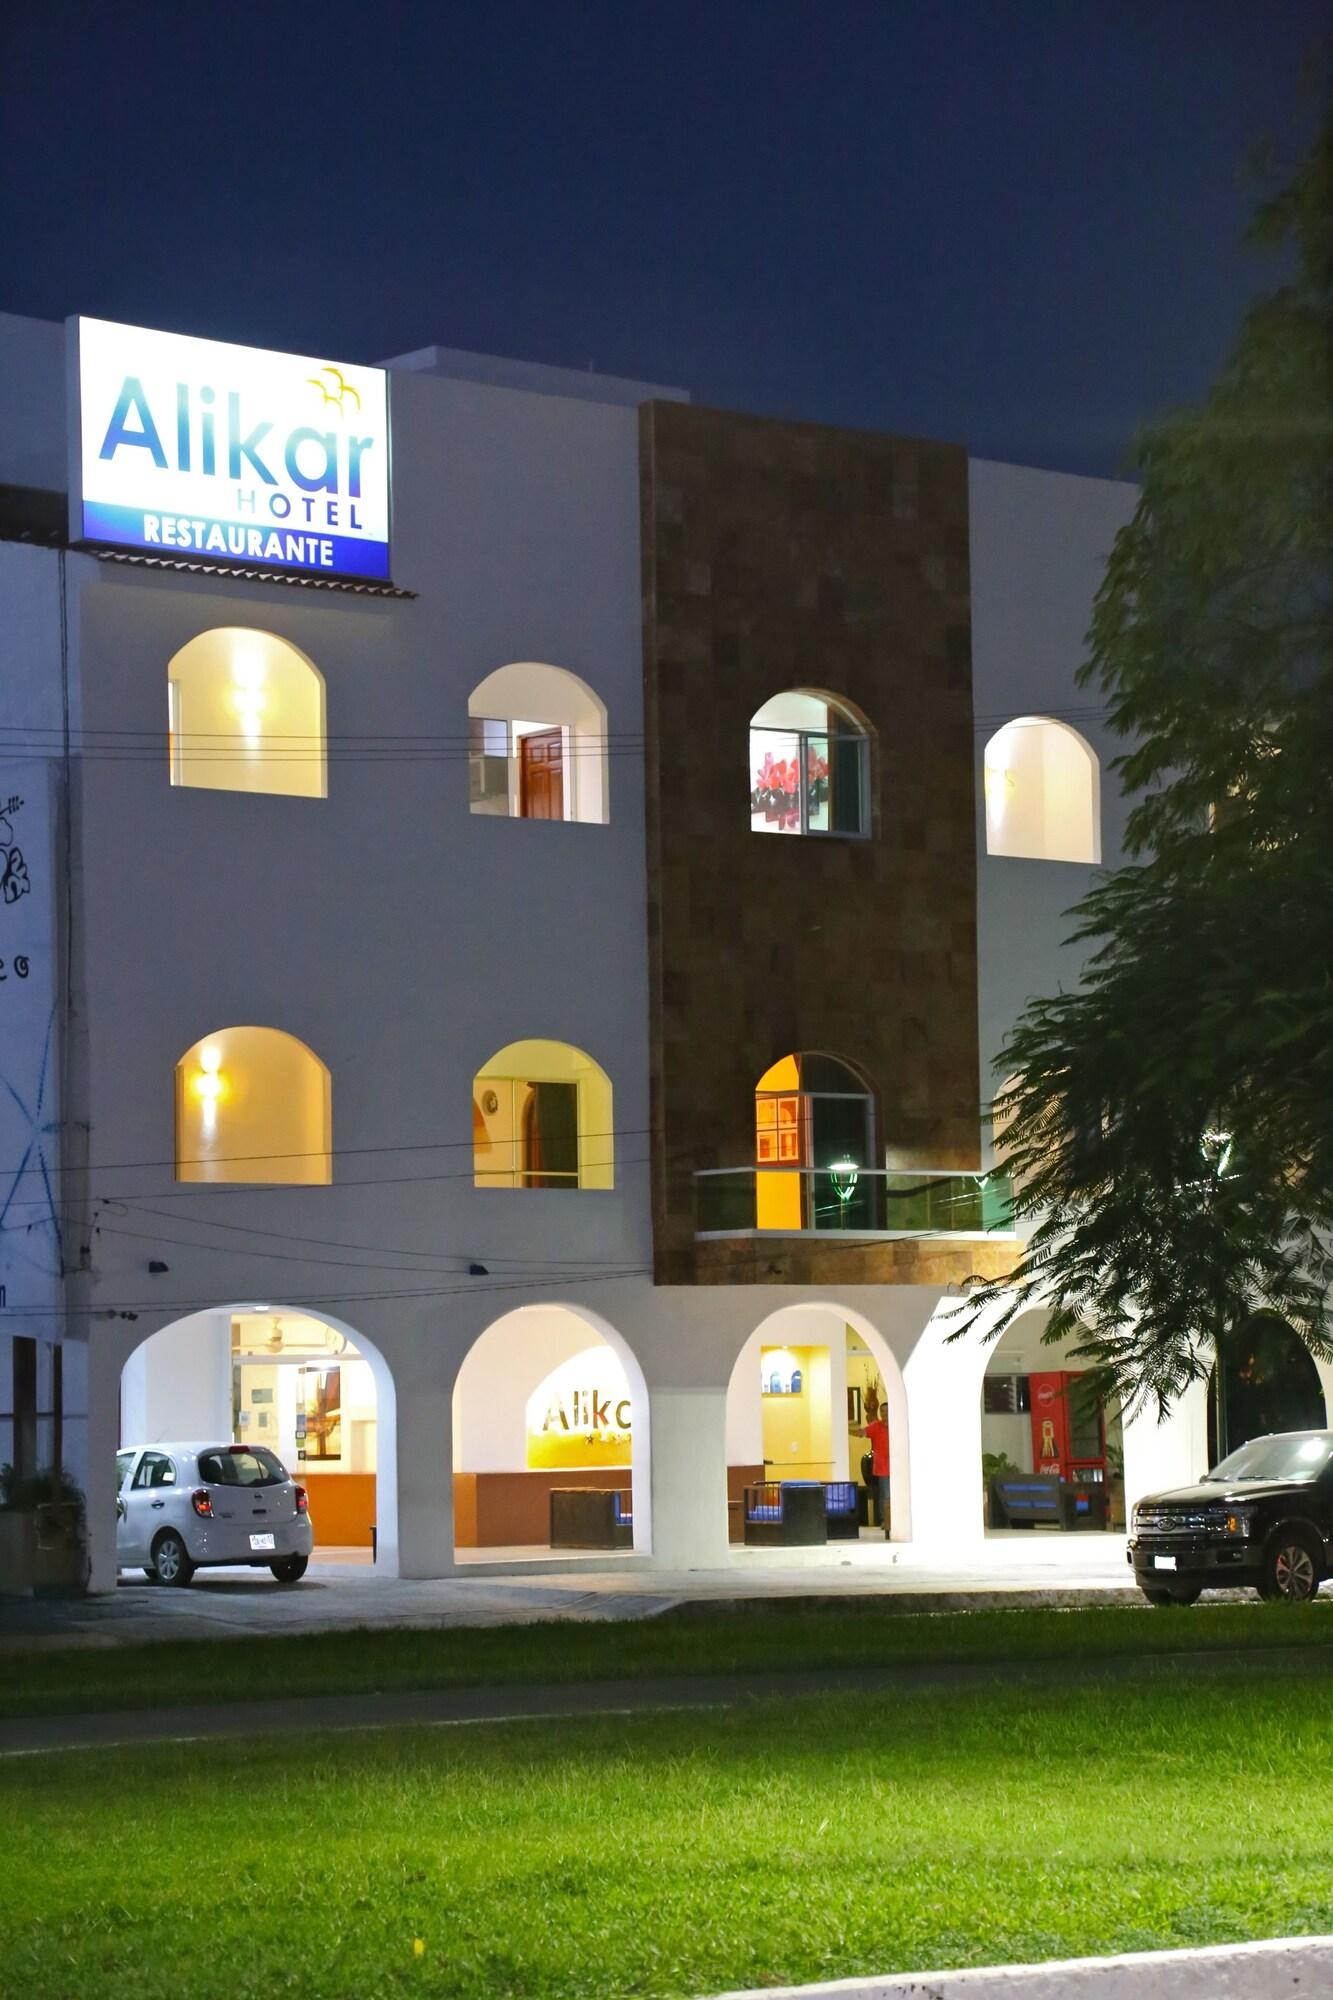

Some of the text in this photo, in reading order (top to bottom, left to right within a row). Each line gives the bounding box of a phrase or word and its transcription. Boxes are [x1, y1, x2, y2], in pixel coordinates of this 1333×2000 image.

[99, 376, 375, 498] Alikar
[237, 487, 363, 530] HOTEL
[143, 513, 334, 567] RESTAURANTE
